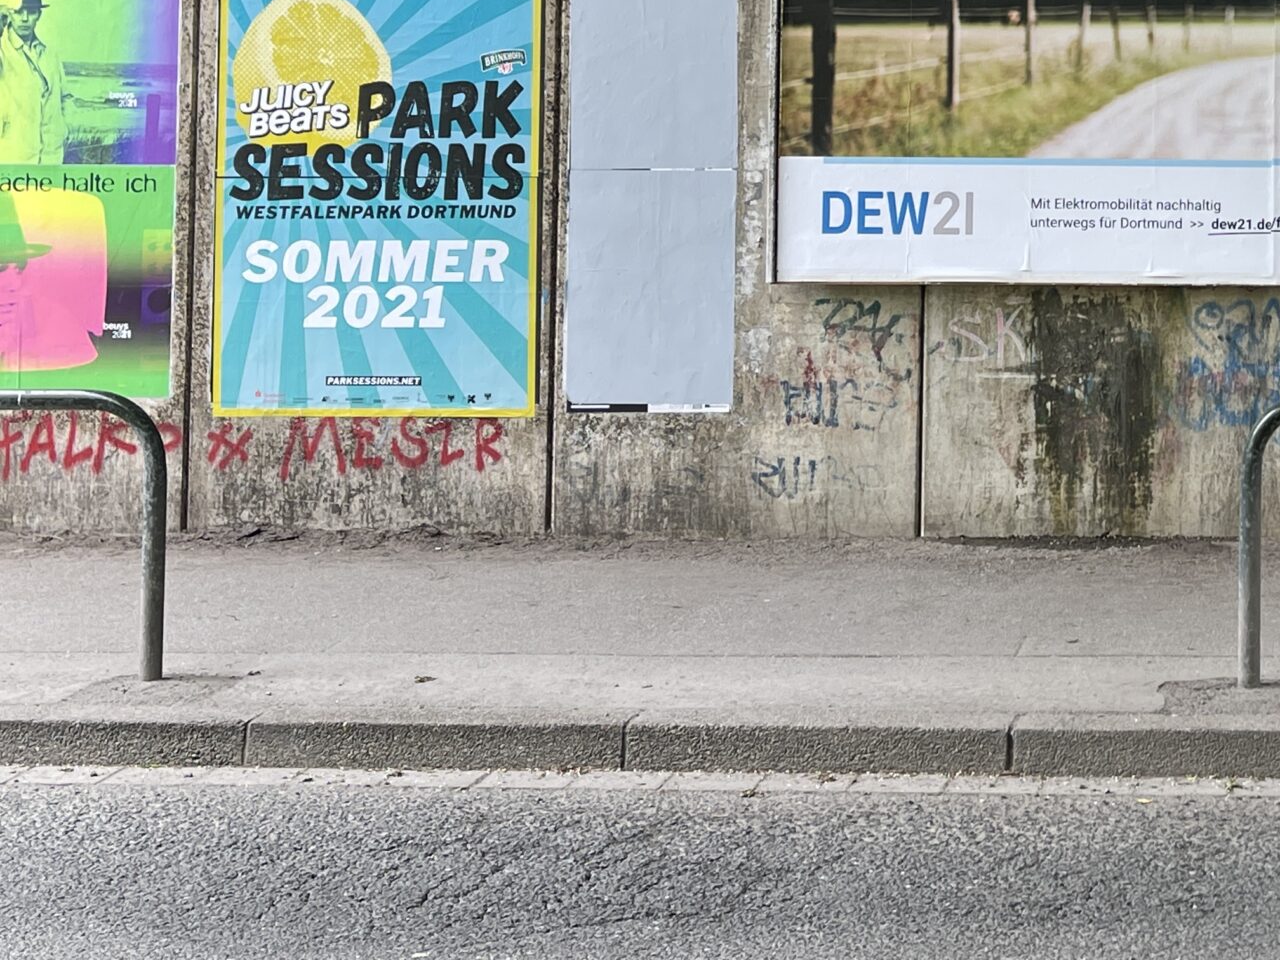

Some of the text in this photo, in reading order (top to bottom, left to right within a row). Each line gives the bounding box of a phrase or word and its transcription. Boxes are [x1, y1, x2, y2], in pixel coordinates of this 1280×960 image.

[239, 80, 335, 114] JUICY
[356, 80, 525, 139] PARK
[62, 172, 115, 193] halte
[125, 172, 157, 193] ich
[228, 142, 526, 202] SESSIONS
[236, 205, 517, 220] WESTFALENPARK DORTMUND
[821, 190, 974, 236] DEW21
[1030, 197, 1222, 214] Mit Elektromobilität nachhaltig
[1030, 217, 1096, 231] unterwegs
[1099, 216, 1117, 229] für
[1120, 217, 1183, 230] Dortmund
[241, 239, 510, 284] SOMMER
[303, 285, 447, 328] 2021
[326, 376, 421, 386] PARKSESSIONS.NET
